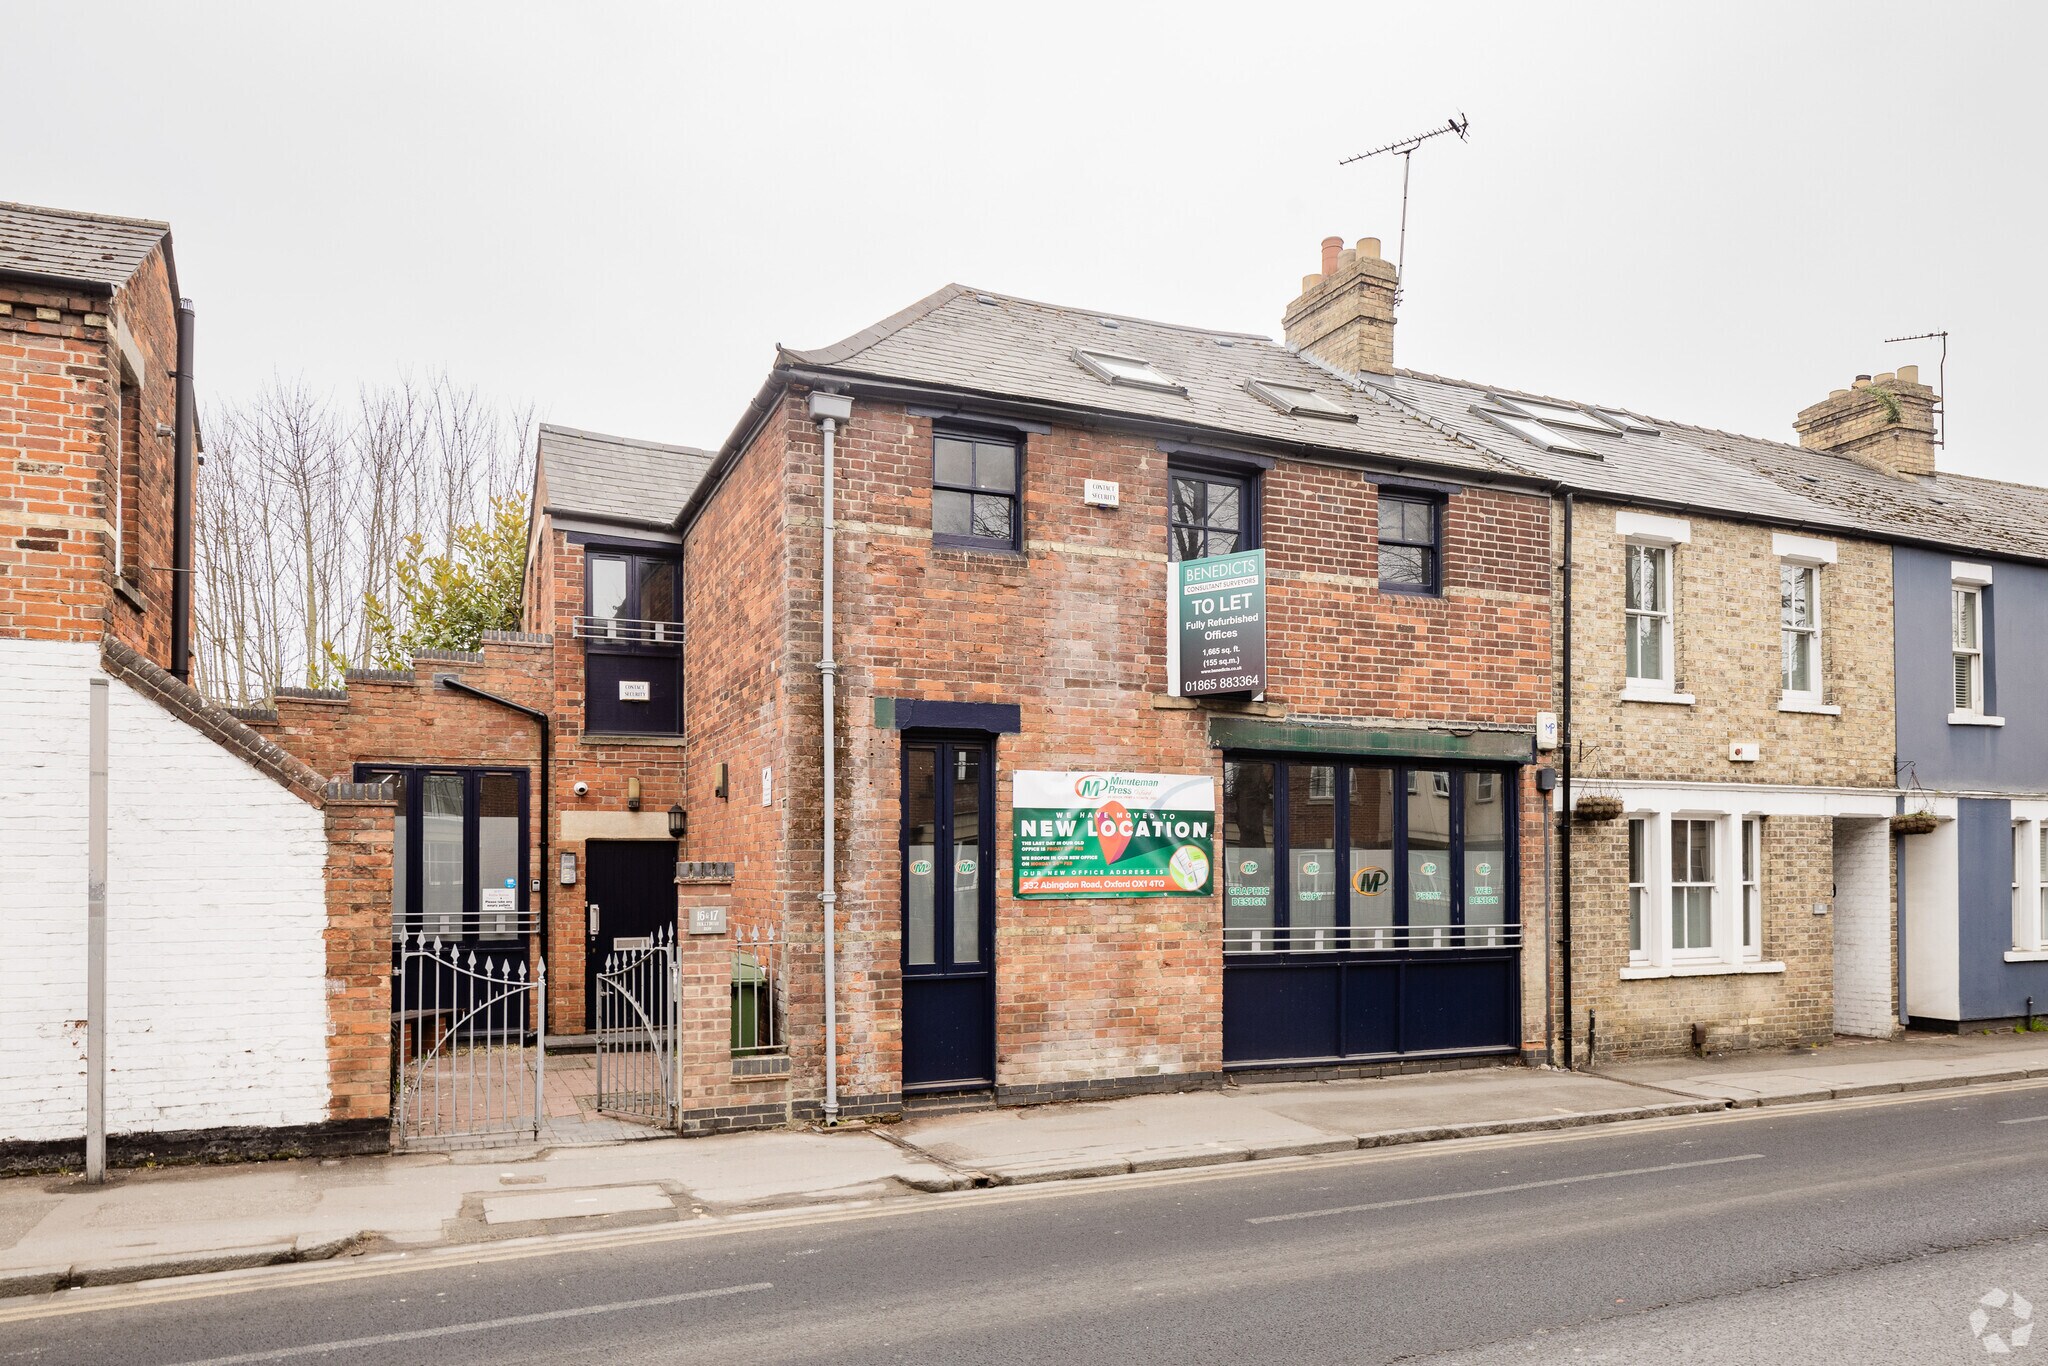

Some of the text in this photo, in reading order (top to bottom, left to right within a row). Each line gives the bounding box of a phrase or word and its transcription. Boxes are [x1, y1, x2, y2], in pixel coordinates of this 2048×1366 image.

[1186, 560, 1256, 581] BENEDICTS
[1186, 577, 1256, 593] CONSULTANT SURVEYORS
[1192, 593, 1253, 615] TO LET
[1186, 612, 1259, 631] Fully Refurbished
[1204, 630, 1238, 640] Offices
[1203, 658, 1218, 668] (155
[1185, 674, 1259, 692] 01865 883364
[1110, 776, 1159, 787] Minuteman
[1108, 785, 1132, 795] Press
[1055, 811, 1072, 819] WE
[1079, 811, 1109, 819] HAVE
[1021, 820, 1208, 838] NEW LOCATION
[1040, 881, 1079, 890] Abingdon
[1080, 880, 1103, 889] Road,
[1103, 880, 1131, 888] Oxford
[1131, 880, 1148, 888] OX1
[1148, 880, 1165, 888] 4TQ
[1360, 869, 1389, 893] MP
[1228, 886, 1270, 895] GRAPHIC
[1474, 886, 1493, 895] WEB
[1300, 892, 1323, 901] COPY
[1416, 892, 1442, 900] PRINT
[1469, 896, 1499, 905] DESIGN
[1231, 897, 1267, 906] DESIGN
[697, 910, 705, 921] 16
[710, 910, 719, 921] 17
